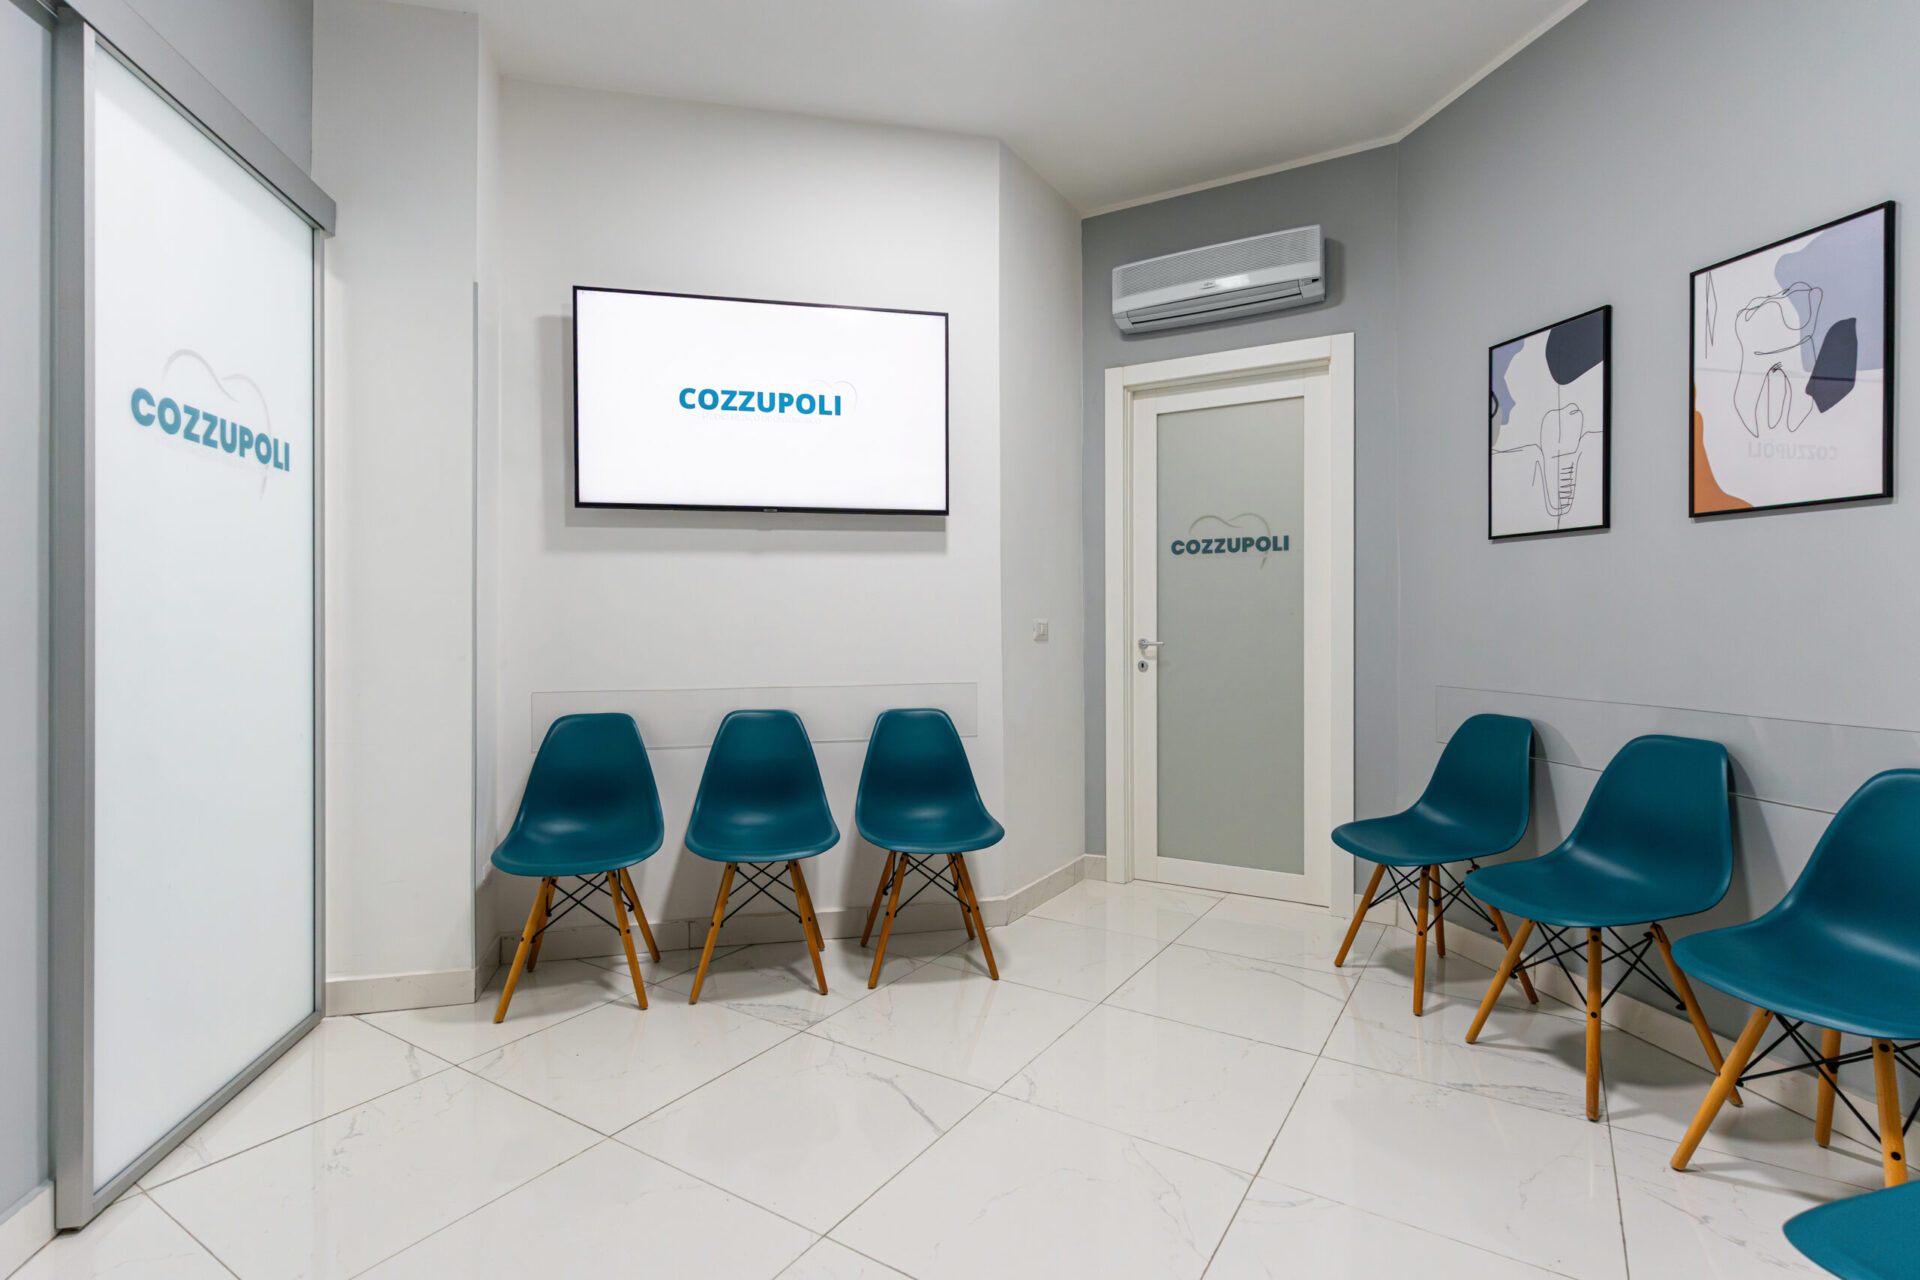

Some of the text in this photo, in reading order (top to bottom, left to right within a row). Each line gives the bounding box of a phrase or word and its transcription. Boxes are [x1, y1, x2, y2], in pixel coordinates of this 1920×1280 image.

[679, 387, 841, 416] COZZUPOLI
[131, 387, 290, 472] COZZUPOLI
[1171, 535, 1289, 555] COZZUPOLI
